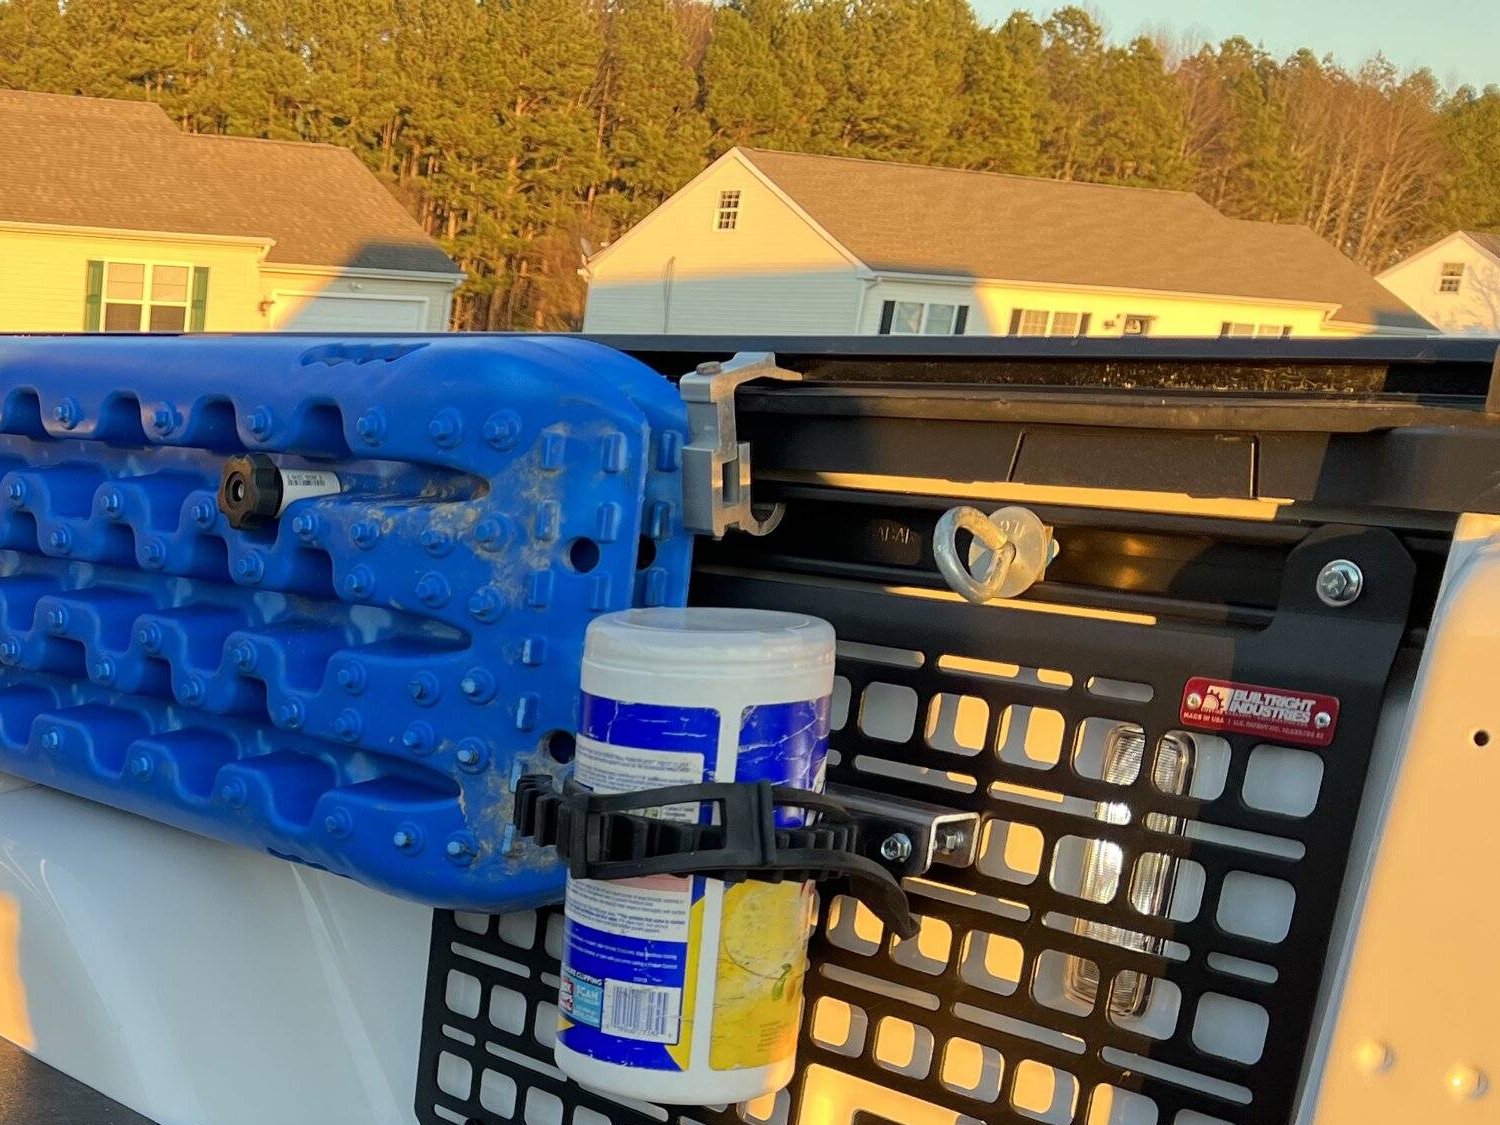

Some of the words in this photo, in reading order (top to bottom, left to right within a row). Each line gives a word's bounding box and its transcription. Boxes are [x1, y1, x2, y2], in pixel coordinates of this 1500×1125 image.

[1233, 689, 1316, 711] BUILTRIGHT
[1183, 711, 1202, 721] MADE
[1202, 713, 1210, 721] IN
[1211, 715, 1224, 723] USA
[1228, 700, 1311, 723] INDUSTRIES
